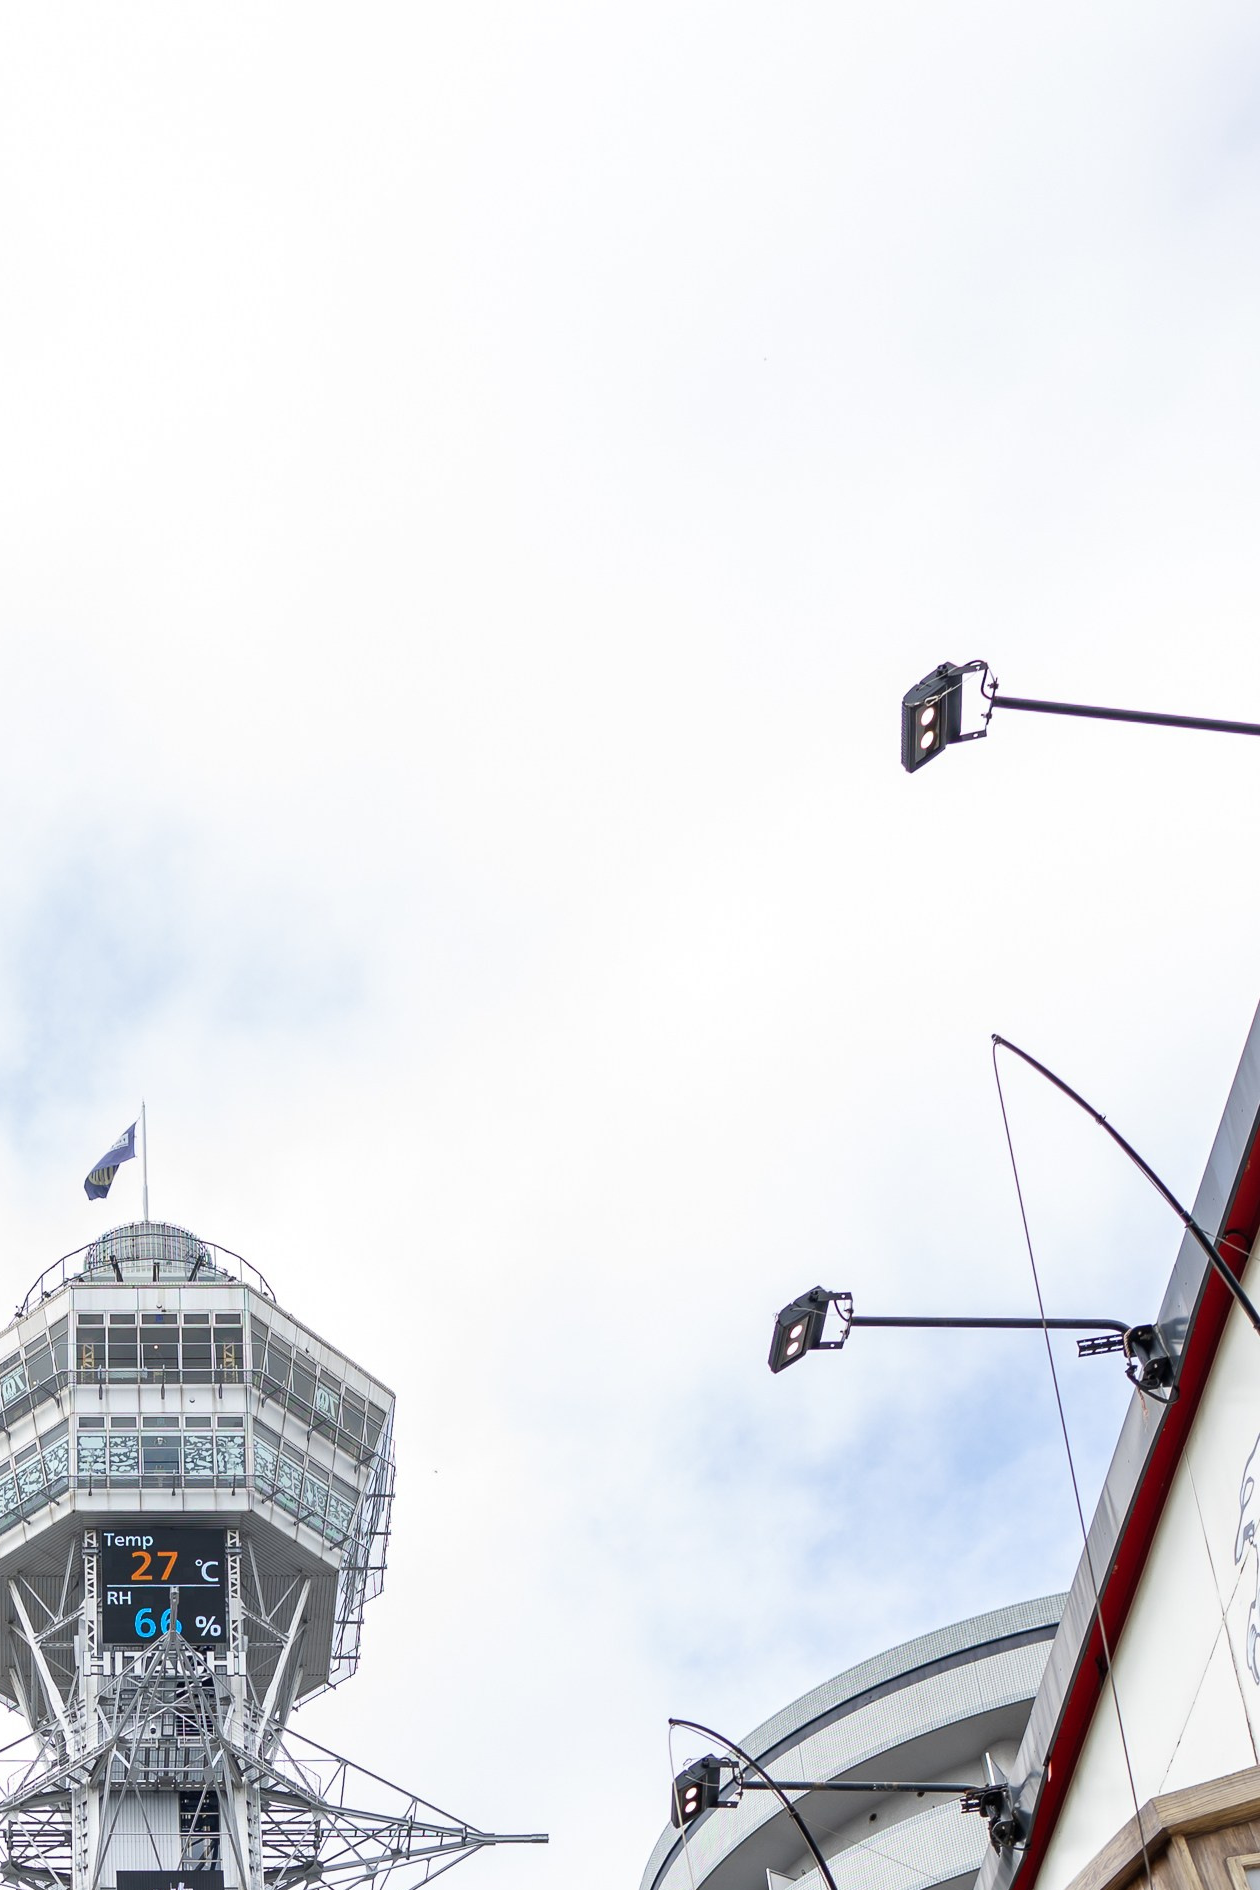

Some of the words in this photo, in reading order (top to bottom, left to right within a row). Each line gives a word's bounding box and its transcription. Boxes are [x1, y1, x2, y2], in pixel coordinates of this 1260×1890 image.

[103, 1532, 154, 1550] Temp
[130, 1551, 179, 1582] 27
[106, 1590, 132, 1606] RH
[134, 1607, 183, 1638] 66
[194, 1615, 222, 1638] %
